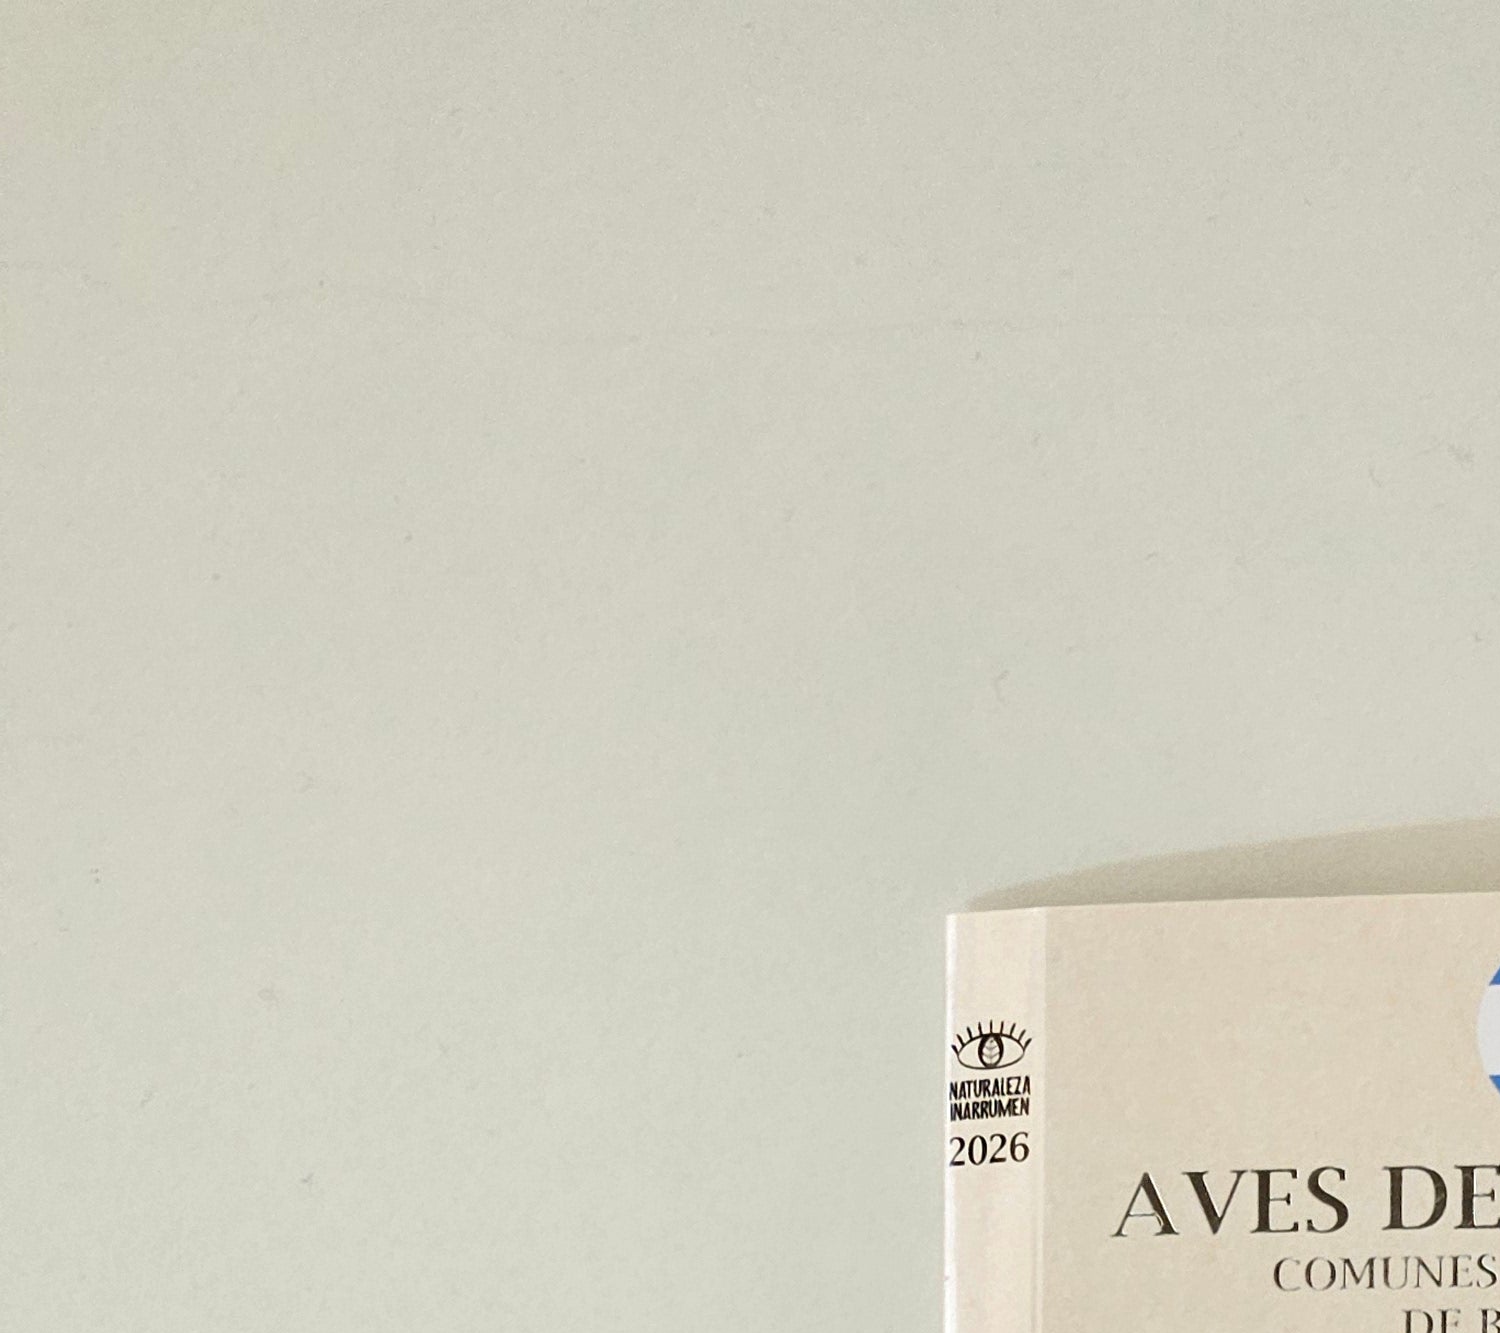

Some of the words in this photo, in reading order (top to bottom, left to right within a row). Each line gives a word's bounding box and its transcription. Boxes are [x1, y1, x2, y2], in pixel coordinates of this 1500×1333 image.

[950, 1076, 1030, 1100] NATURALEZA
[950, 1098, 1029, 1121] INARRUMEN
[949, 1132, 1029, 1166] 2026
[1110, 1166, 1351, 1237] AVES
[1273, 1253, 1498, 1292] COMUNES
